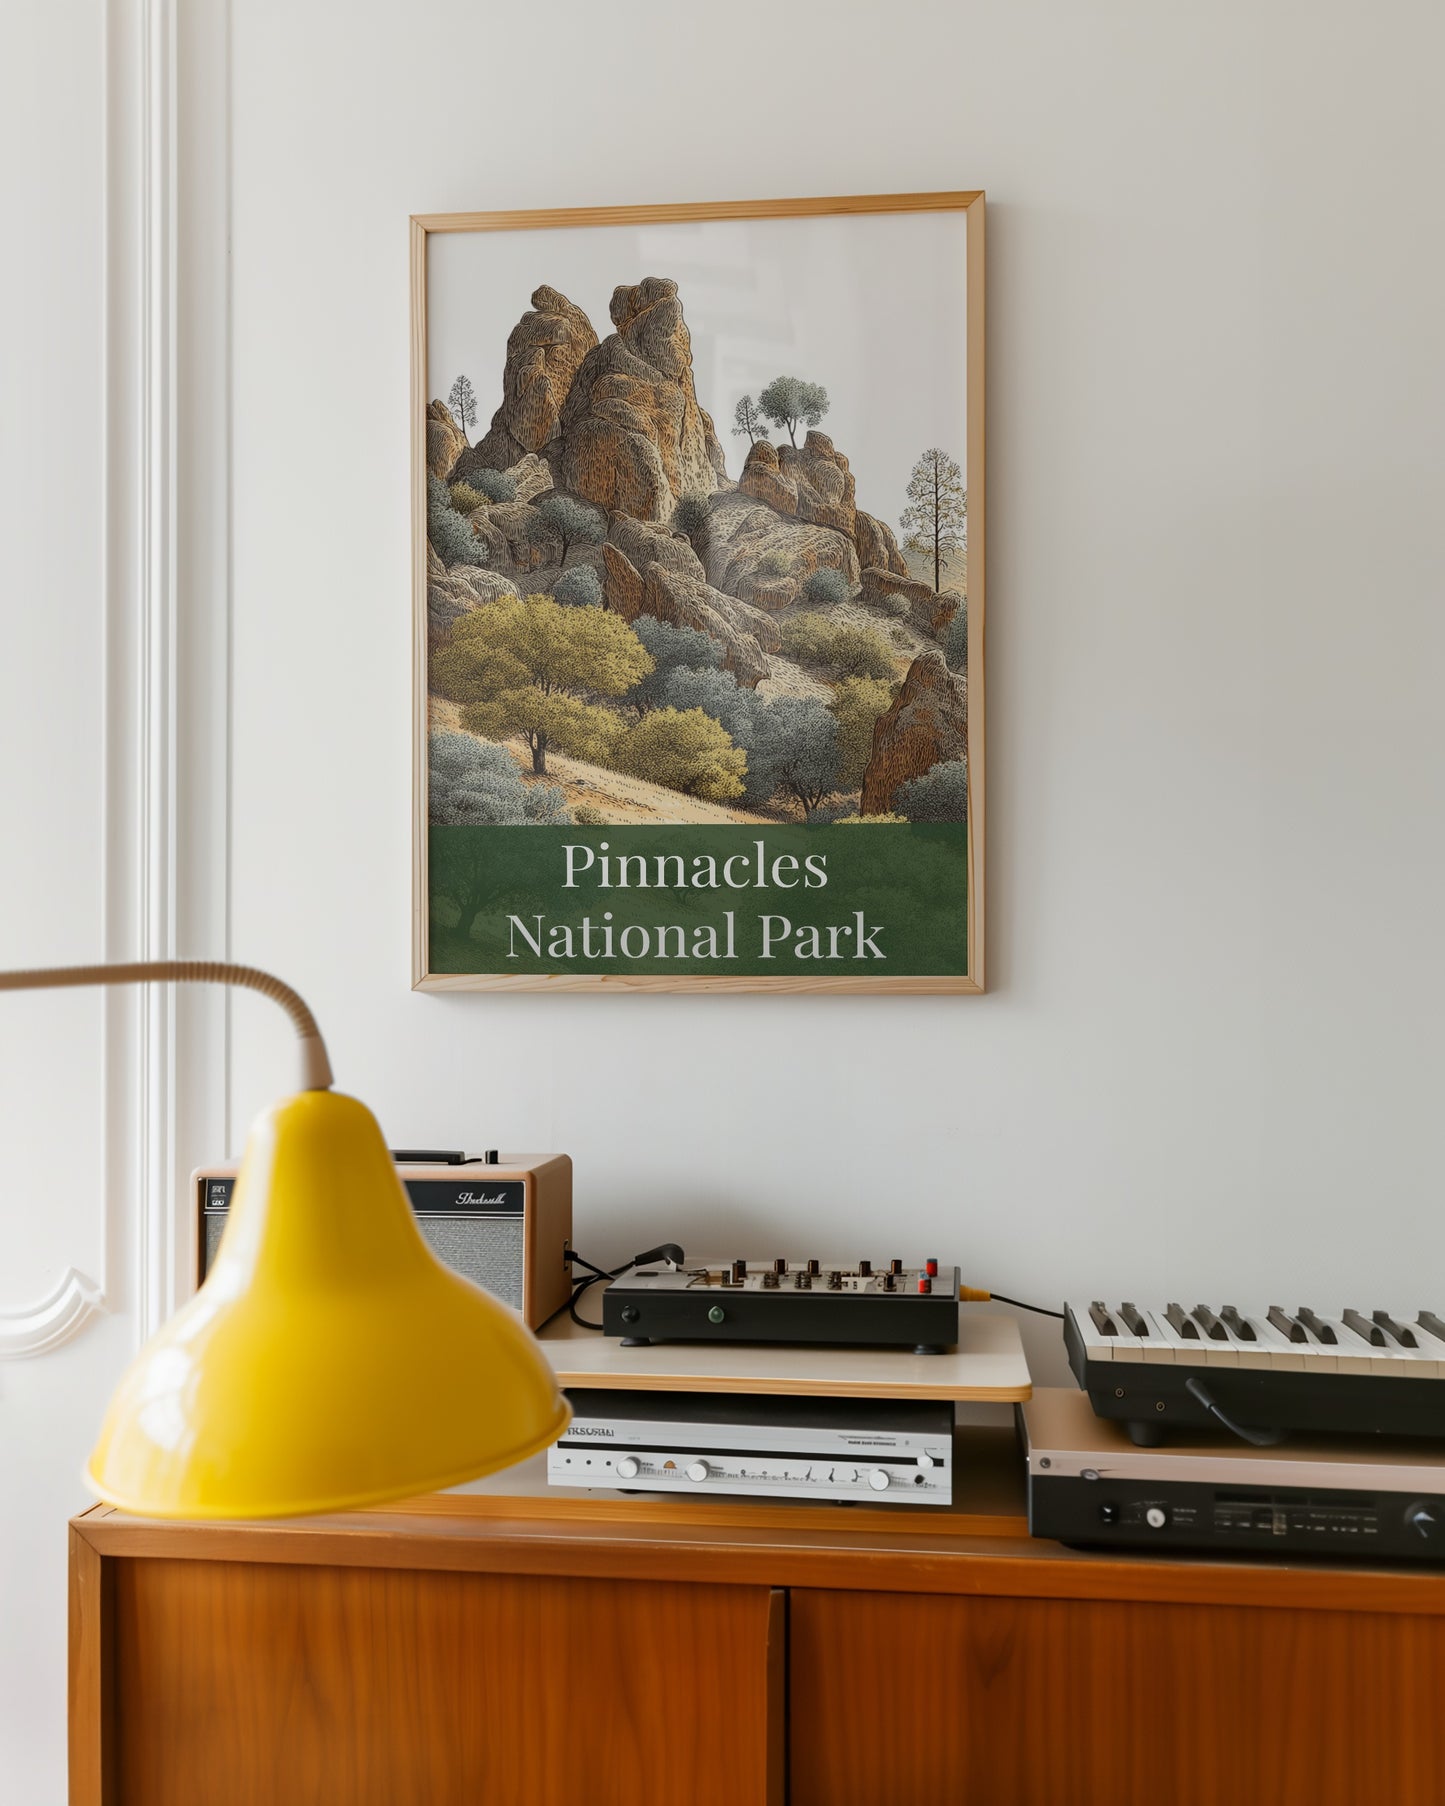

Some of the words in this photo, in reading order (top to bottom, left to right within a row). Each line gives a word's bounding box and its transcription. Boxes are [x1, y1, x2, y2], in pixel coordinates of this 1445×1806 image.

[562, 841, 828, 889] Pinnacles
[506, 911, 738, 959] National
[758, 911, 887, 959] Park
